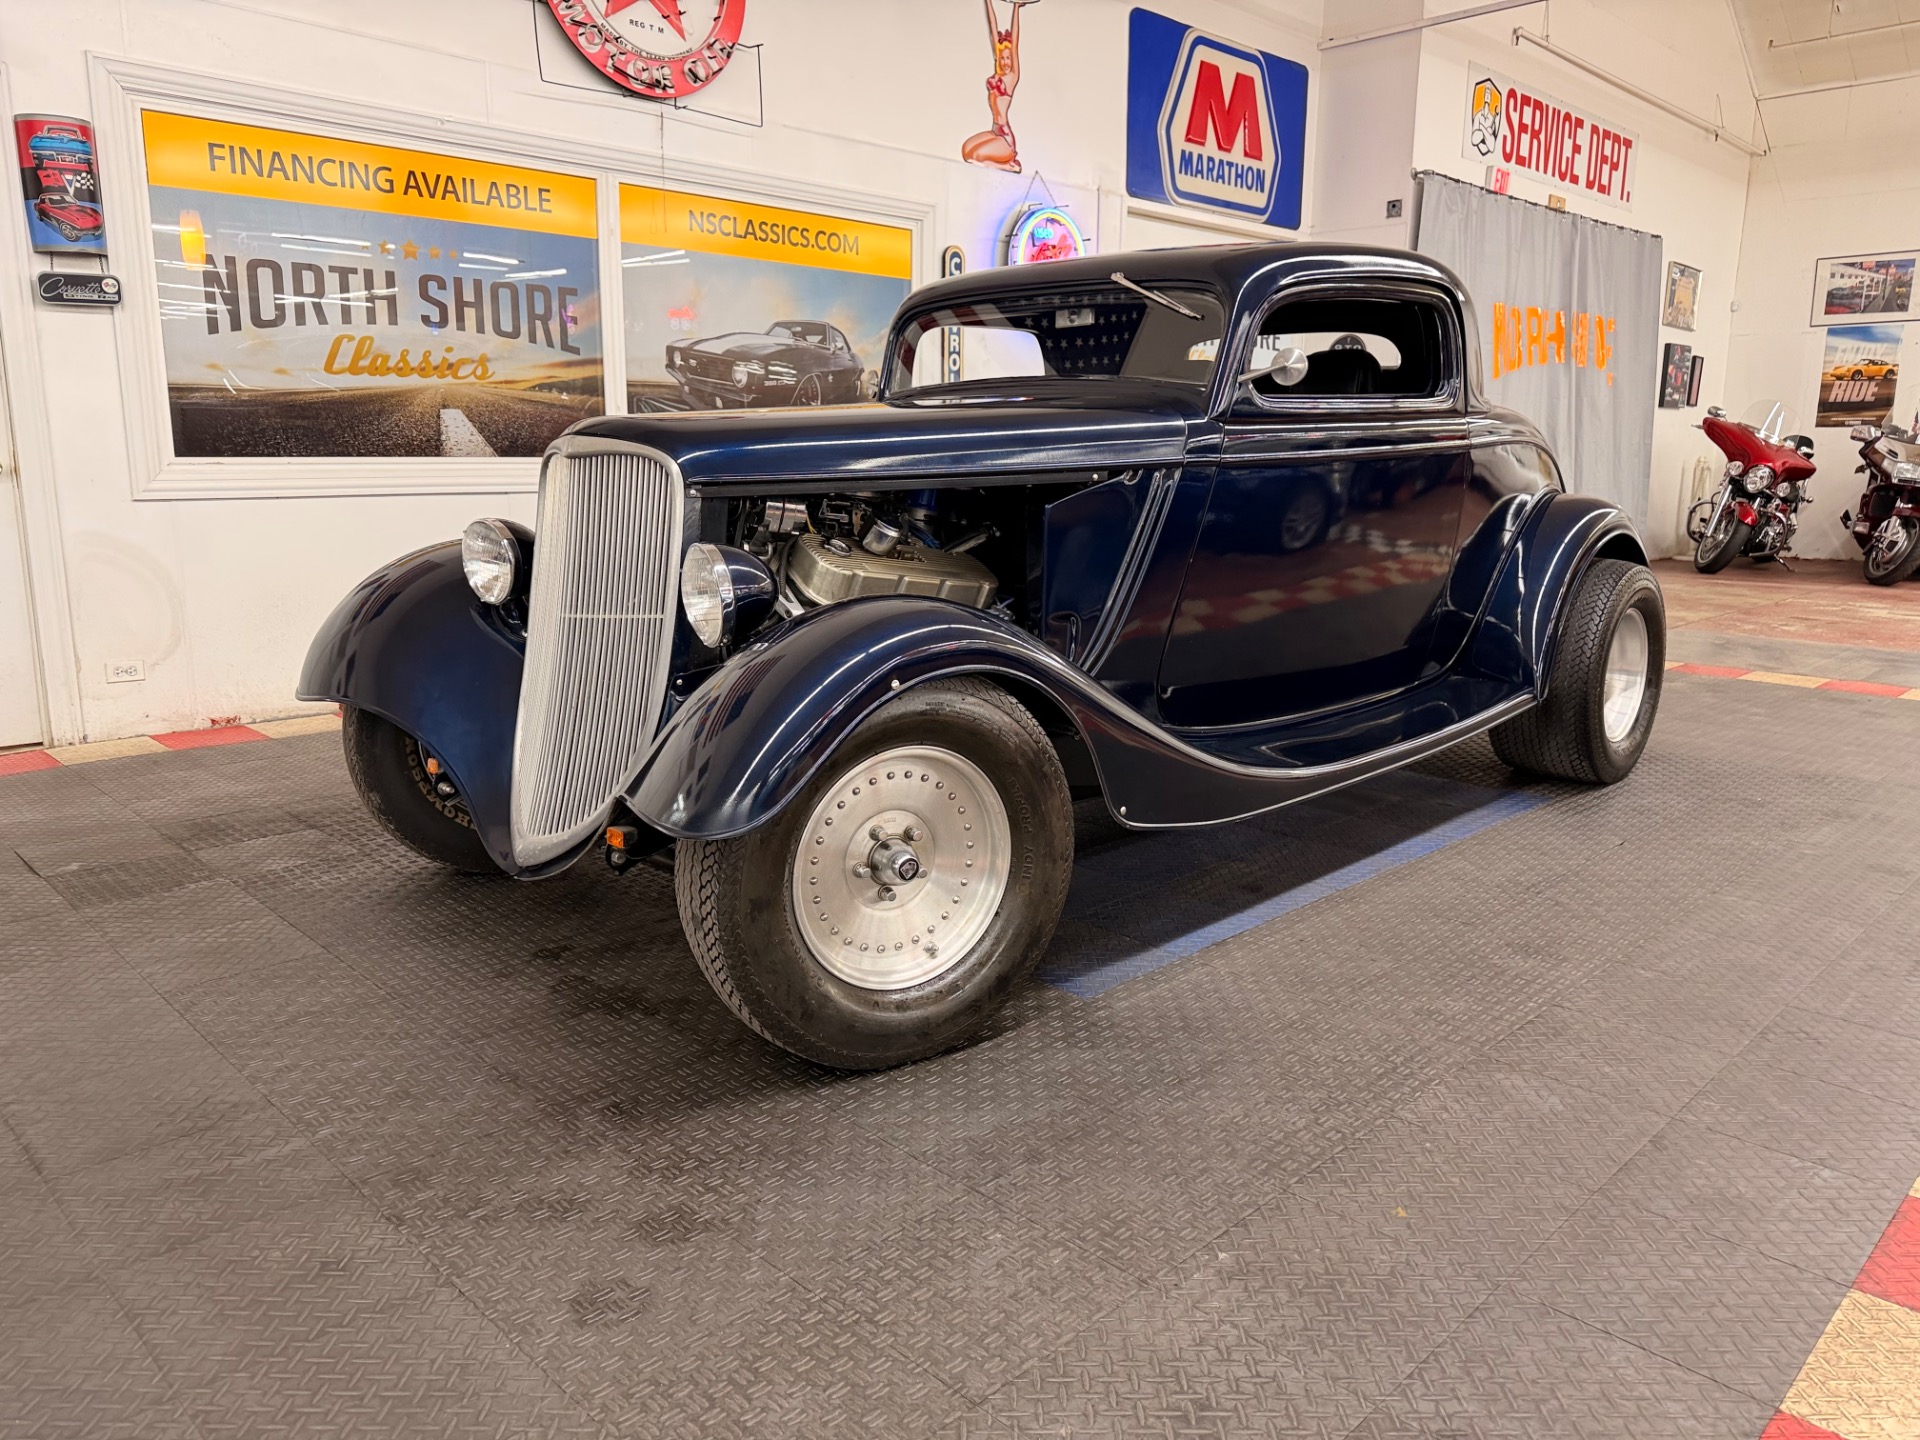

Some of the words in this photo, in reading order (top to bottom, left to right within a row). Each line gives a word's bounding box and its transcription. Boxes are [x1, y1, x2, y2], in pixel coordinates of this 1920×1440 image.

[629, 18, 646, 29] REG
[631, 46, 643, 56] THE
[1184, 59, 1262, 161] M
[1502, 87, 1584, 185] SERVICE
[1585, 123, 1632, 203] DEPT.
[207, 142, 395, 194] FINANCING
[402, 169, 553, 214] AVAILABLE
[1178, 149, 1266, 193] MARATHON
[1493, 168, 1511, 193] EXIT
[688, 209, 860, 256] NSCLASSICS.COM
[41, 276, 102, 297] Corvette
[202, 253, 399, 335] NORTH
[418, 273, 581, 357] SHORE
[323, 333, 496, 381] Classics
[1828, 380, 1879, 403] RIDE
[1022, 845, 1033, 879] INDY
